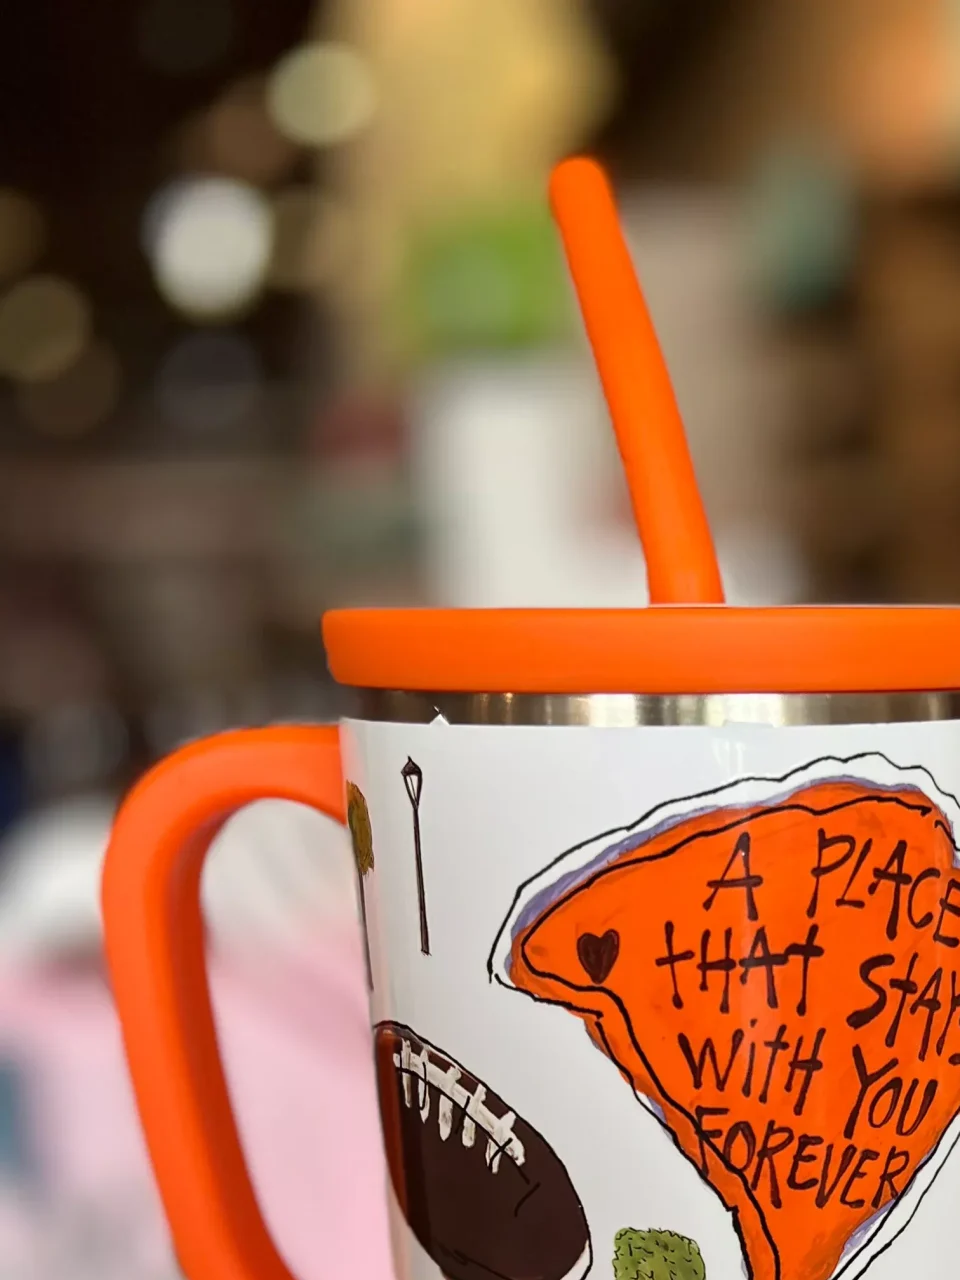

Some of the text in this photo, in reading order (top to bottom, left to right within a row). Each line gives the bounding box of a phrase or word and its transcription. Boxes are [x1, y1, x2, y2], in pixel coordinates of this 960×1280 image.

[702, 831, 764, 922] A
[843, 1044, 939, 1140] YOU
[694, 1105, 911, 1210] FOREVER
